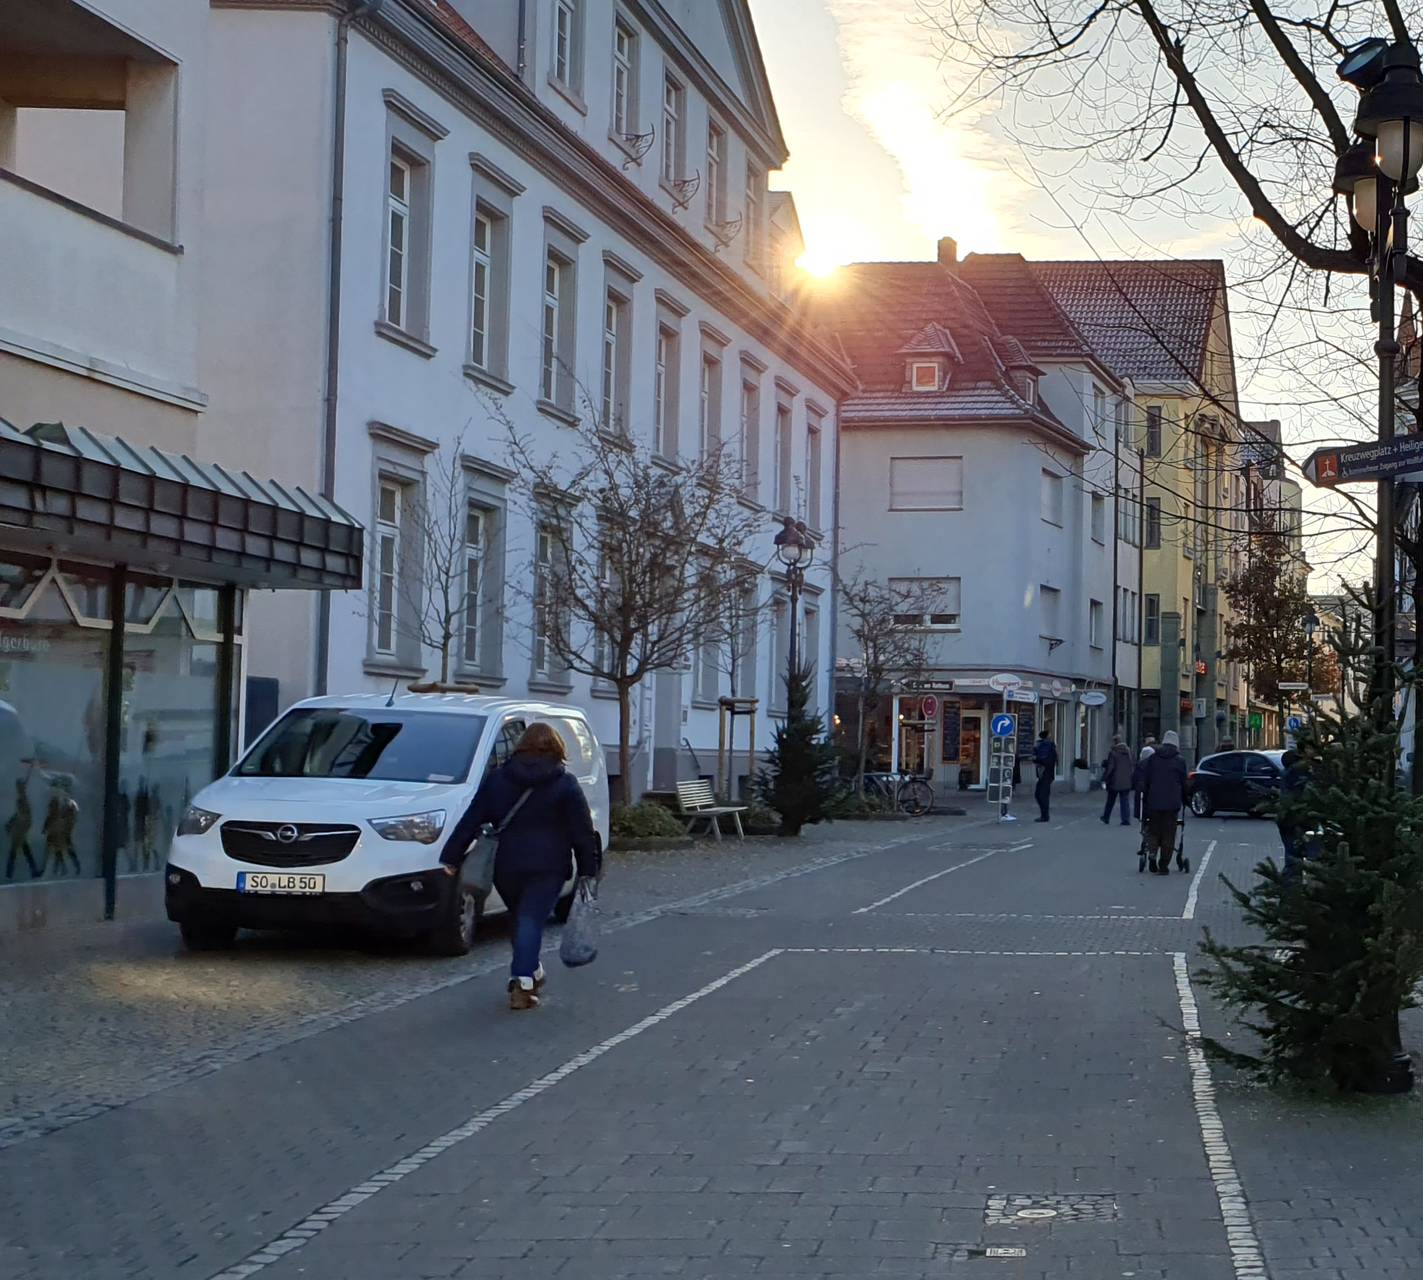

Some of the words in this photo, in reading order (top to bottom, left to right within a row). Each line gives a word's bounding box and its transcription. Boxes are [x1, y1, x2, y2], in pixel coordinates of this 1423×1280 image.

[1340, 446, 1392, 464] Kreuzwegplatz
[1399, 440, 1423, 454] Heilige
[250, 875, 269, 889] SO
[277, 876, 296, 890] LB
[299, 877, 317, 890] 50
